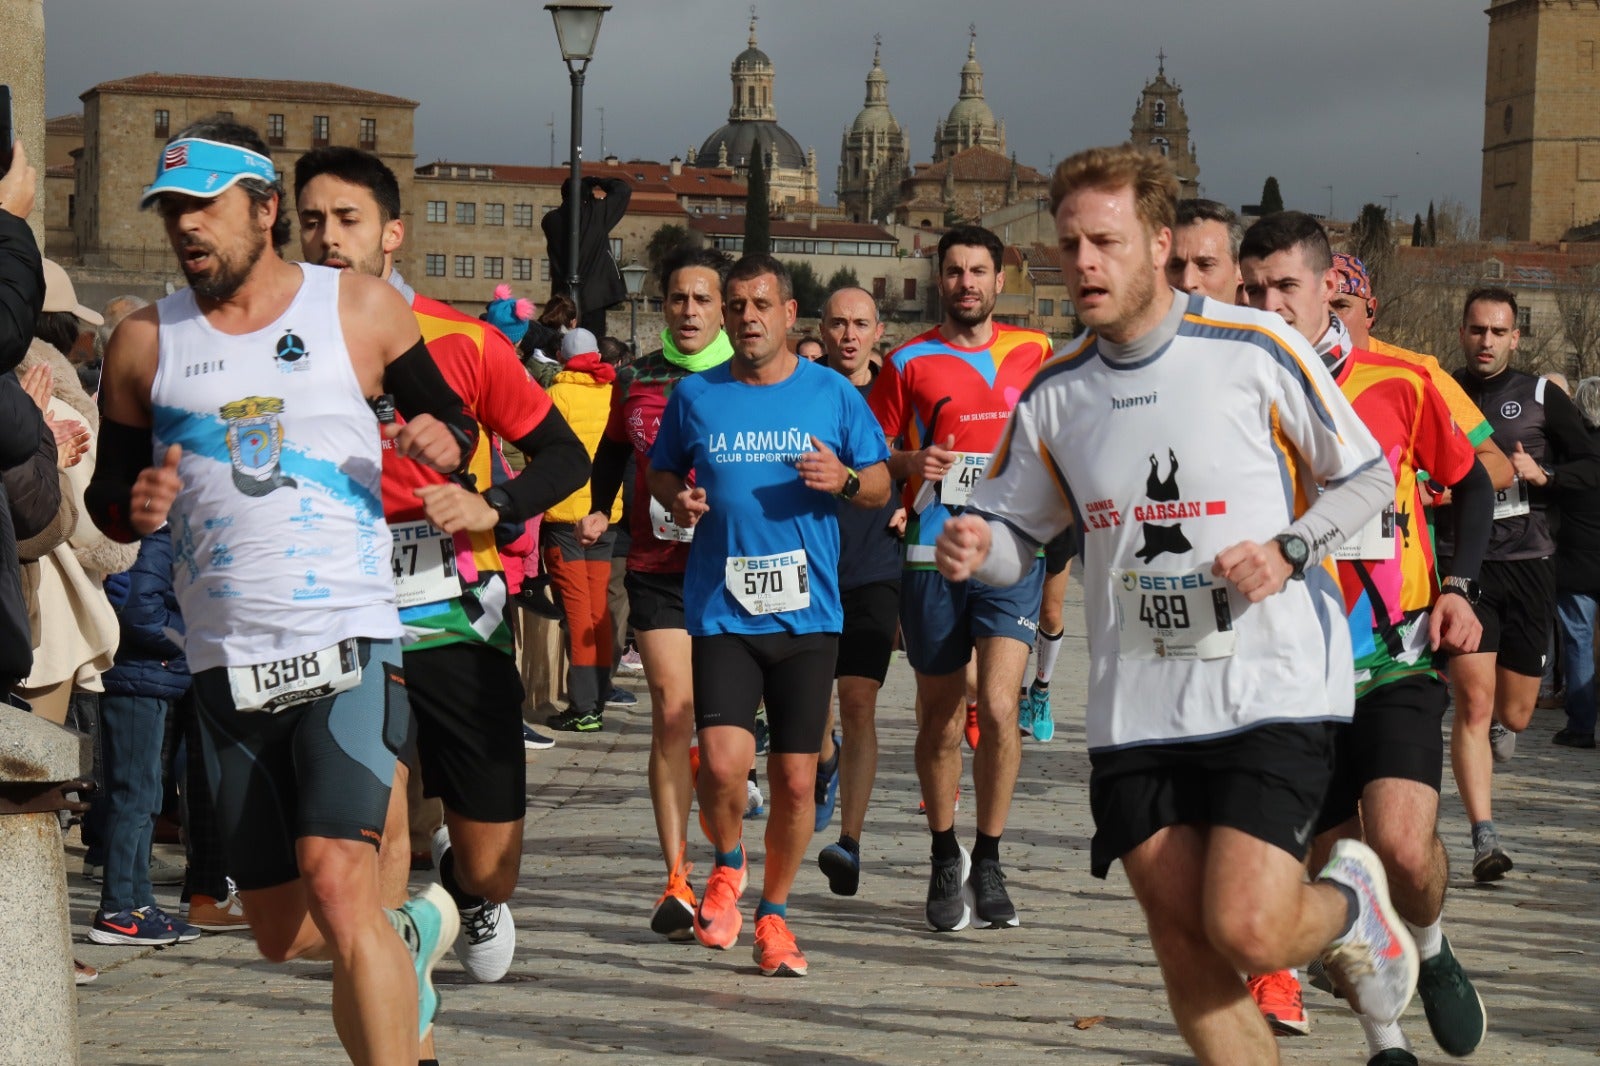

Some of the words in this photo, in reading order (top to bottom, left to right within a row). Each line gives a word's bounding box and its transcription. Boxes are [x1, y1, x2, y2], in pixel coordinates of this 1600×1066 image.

[709, 433, 728, 453] LA
[733, 427, 813, 452] ARMUÑA
[716, 453, 742, 463] CLUB
[965, 456, 991, 465] SE
[1134, 502, 1201, 522] GARSAN
[390, 524, 441, 541] ETEL
[747, 556, 798, 569] SETEL
[744, 570, 783, 595] 570
[1139, 573, 1213, 590] SETEL
[1139, 594, 1190, 629] 489
[251, 651, 320, 694] 1398
